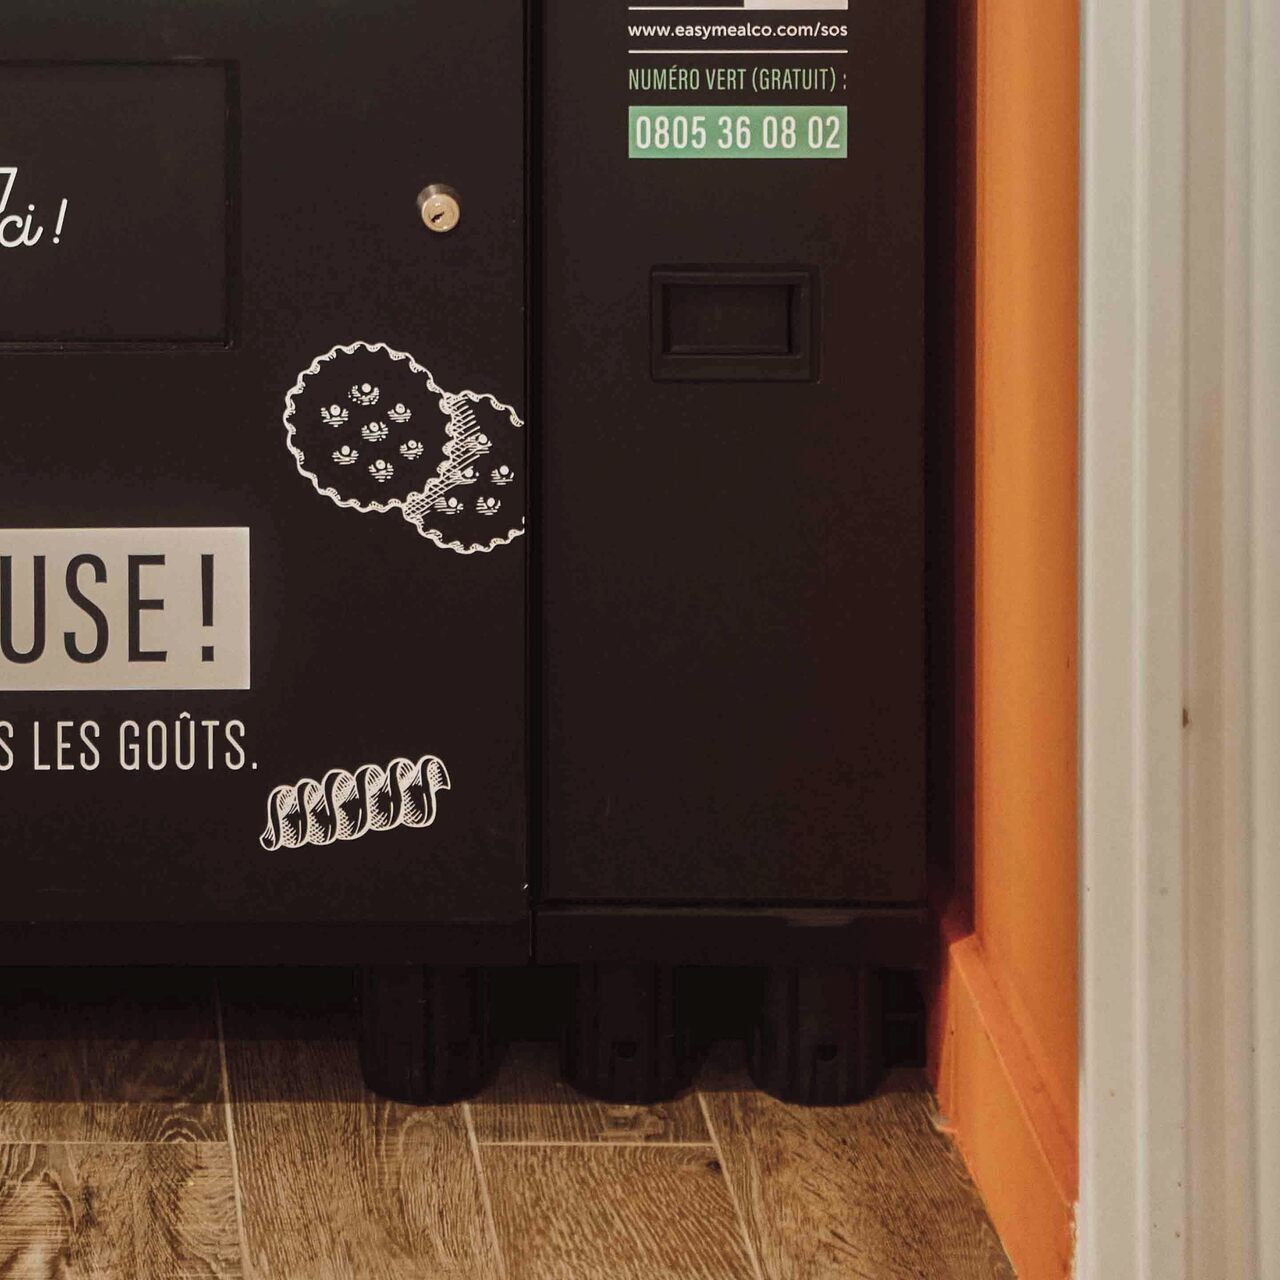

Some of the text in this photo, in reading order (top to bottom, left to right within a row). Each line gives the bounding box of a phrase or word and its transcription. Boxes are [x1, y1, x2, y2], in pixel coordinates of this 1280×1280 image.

[628, 21, 849, 40] www.easymealco.com/sos
[629, 64, 837, 92] NUMÉRO VERT (GRATUIT)
[635, 115, 841, 150] 0805 36 08 02
[33, 720, 102, 771] LES
[119, 711, 259, 771] GOÛTS.
